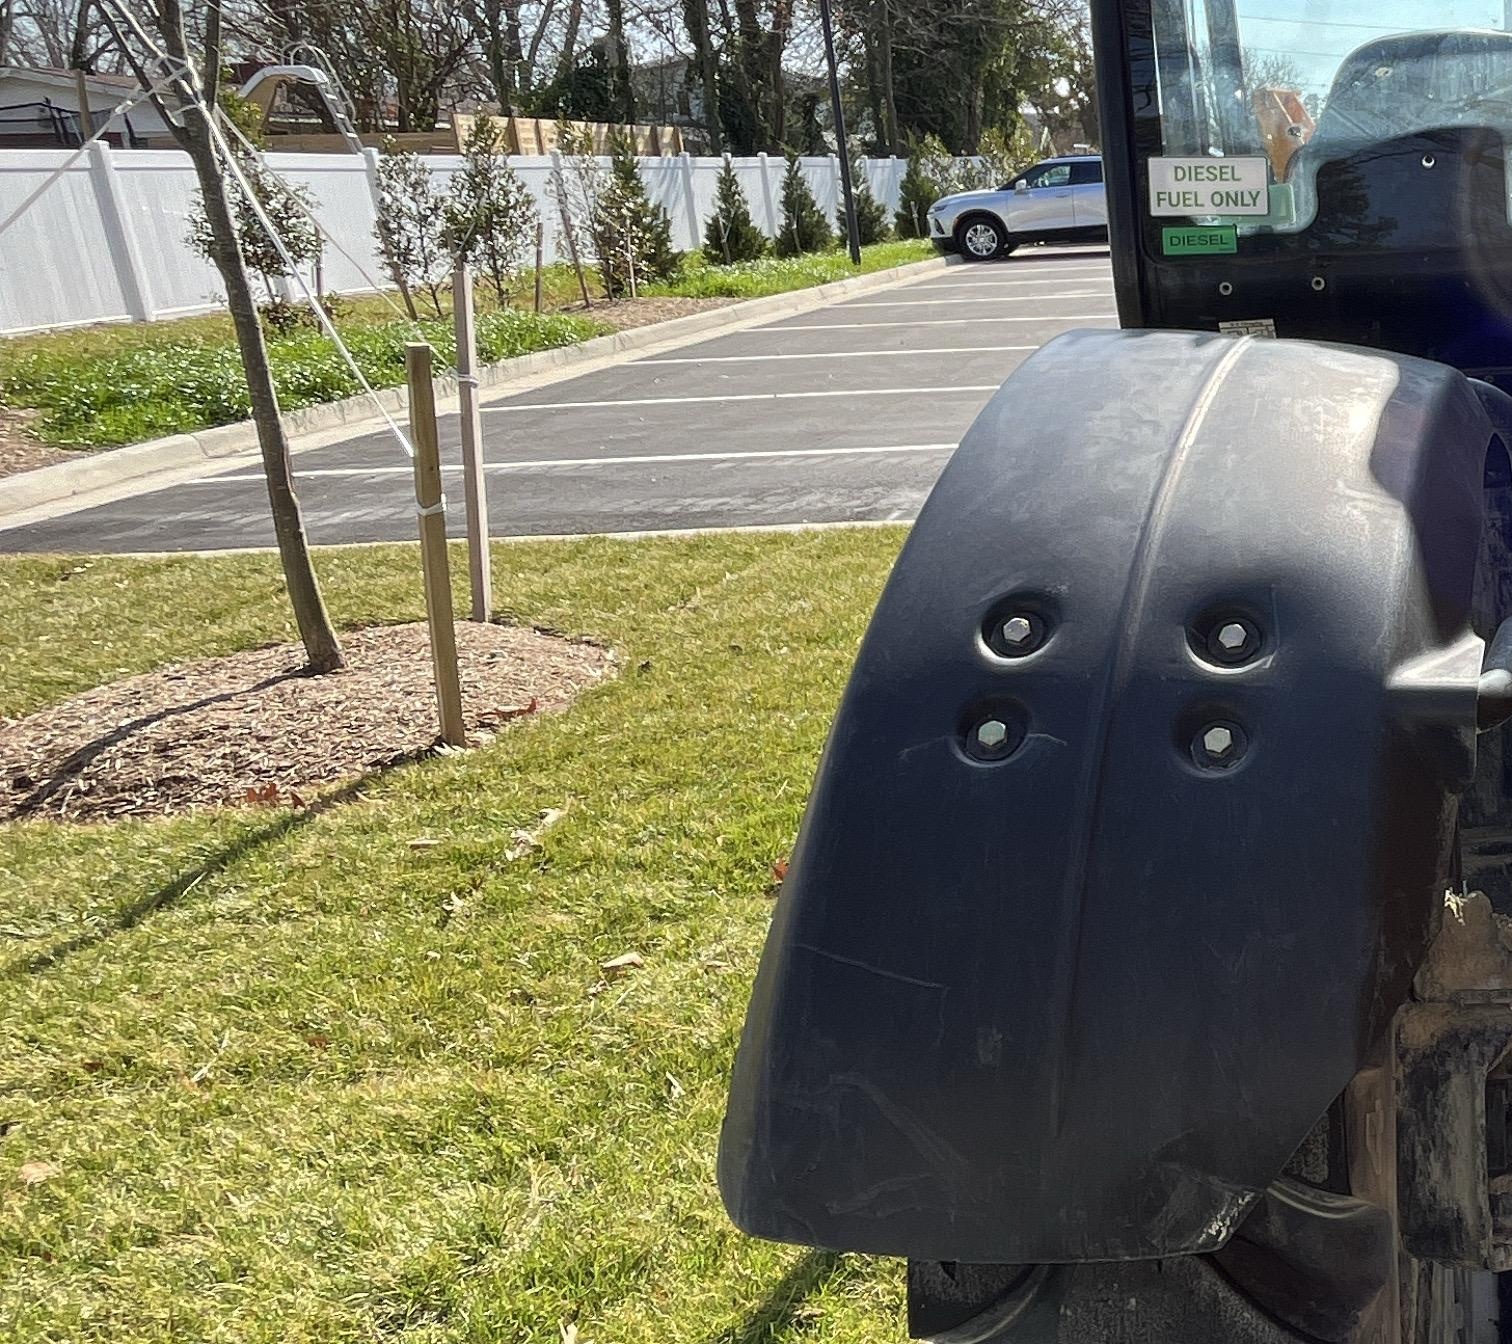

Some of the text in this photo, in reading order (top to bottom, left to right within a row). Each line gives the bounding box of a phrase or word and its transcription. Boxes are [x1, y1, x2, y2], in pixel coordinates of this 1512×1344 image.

[1174, 165, 1242, 182] DIESEL
[1156, 190, 1261, 207] FUEL ONLY
[1169, 235, 1229, 247] DIESEL
